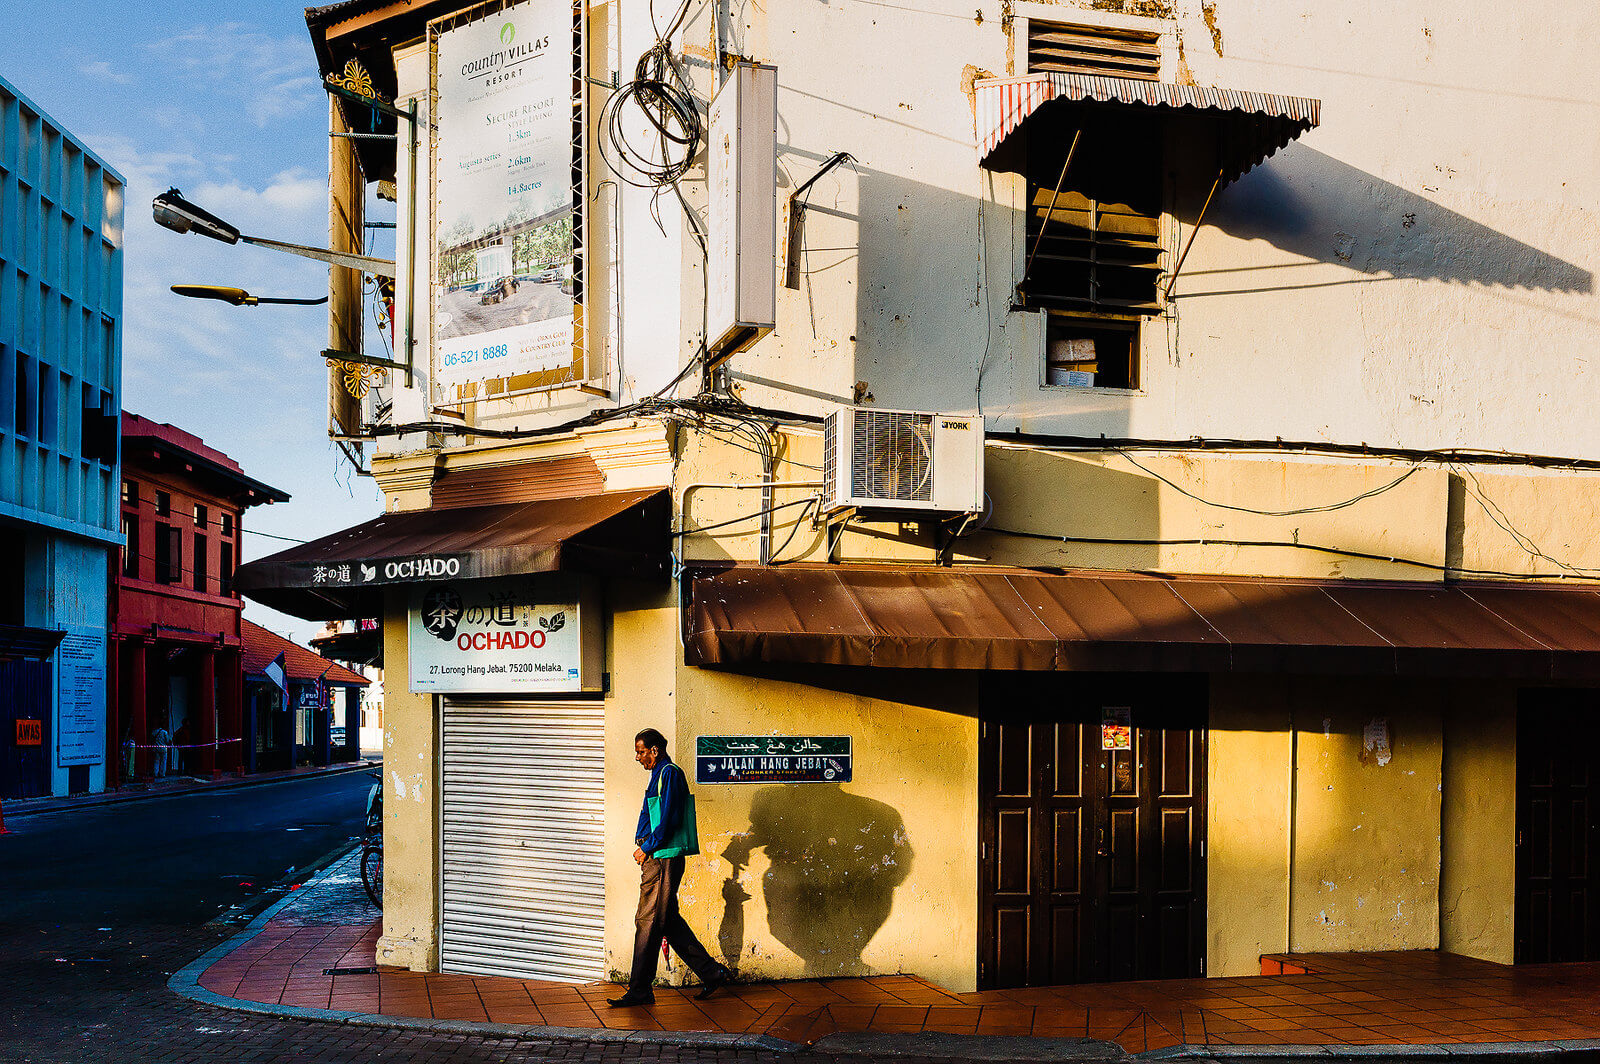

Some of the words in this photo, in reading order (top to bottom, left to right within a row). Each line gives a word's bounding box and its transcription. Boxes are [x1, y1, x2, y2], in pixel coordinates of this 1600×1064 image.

[486, 68, 523, 87] RESORT
[486, 108, 519, 126] SECURE
[521, 97, 555, 115] RESORT
[507, 155, 533, 169] 2.6km
[507, 180, 542, 196] 14.8acres
[444, 349, 479, 367] 06-521
[482, 343, 508, 361] 8888
[948, 421, 968, 430] YORK
[312, 564, 351, 583] 茶の道
[385, 558, 460, 579] OCHADO
[427, 589, 519, 629] 茶の道
[457, 630, 546, 652] OCHADO
[441, 665, 466, 676] Lorong
[466, 664, 486, 676] Hang
[509, 663, 533, 673] 75200
[18, 723, 41, 741] AWAS
[721, 758, 755, 770] JALAN
[760, 757, 789, 770] HANG
[795, 757, 828, 770] JEBAT
